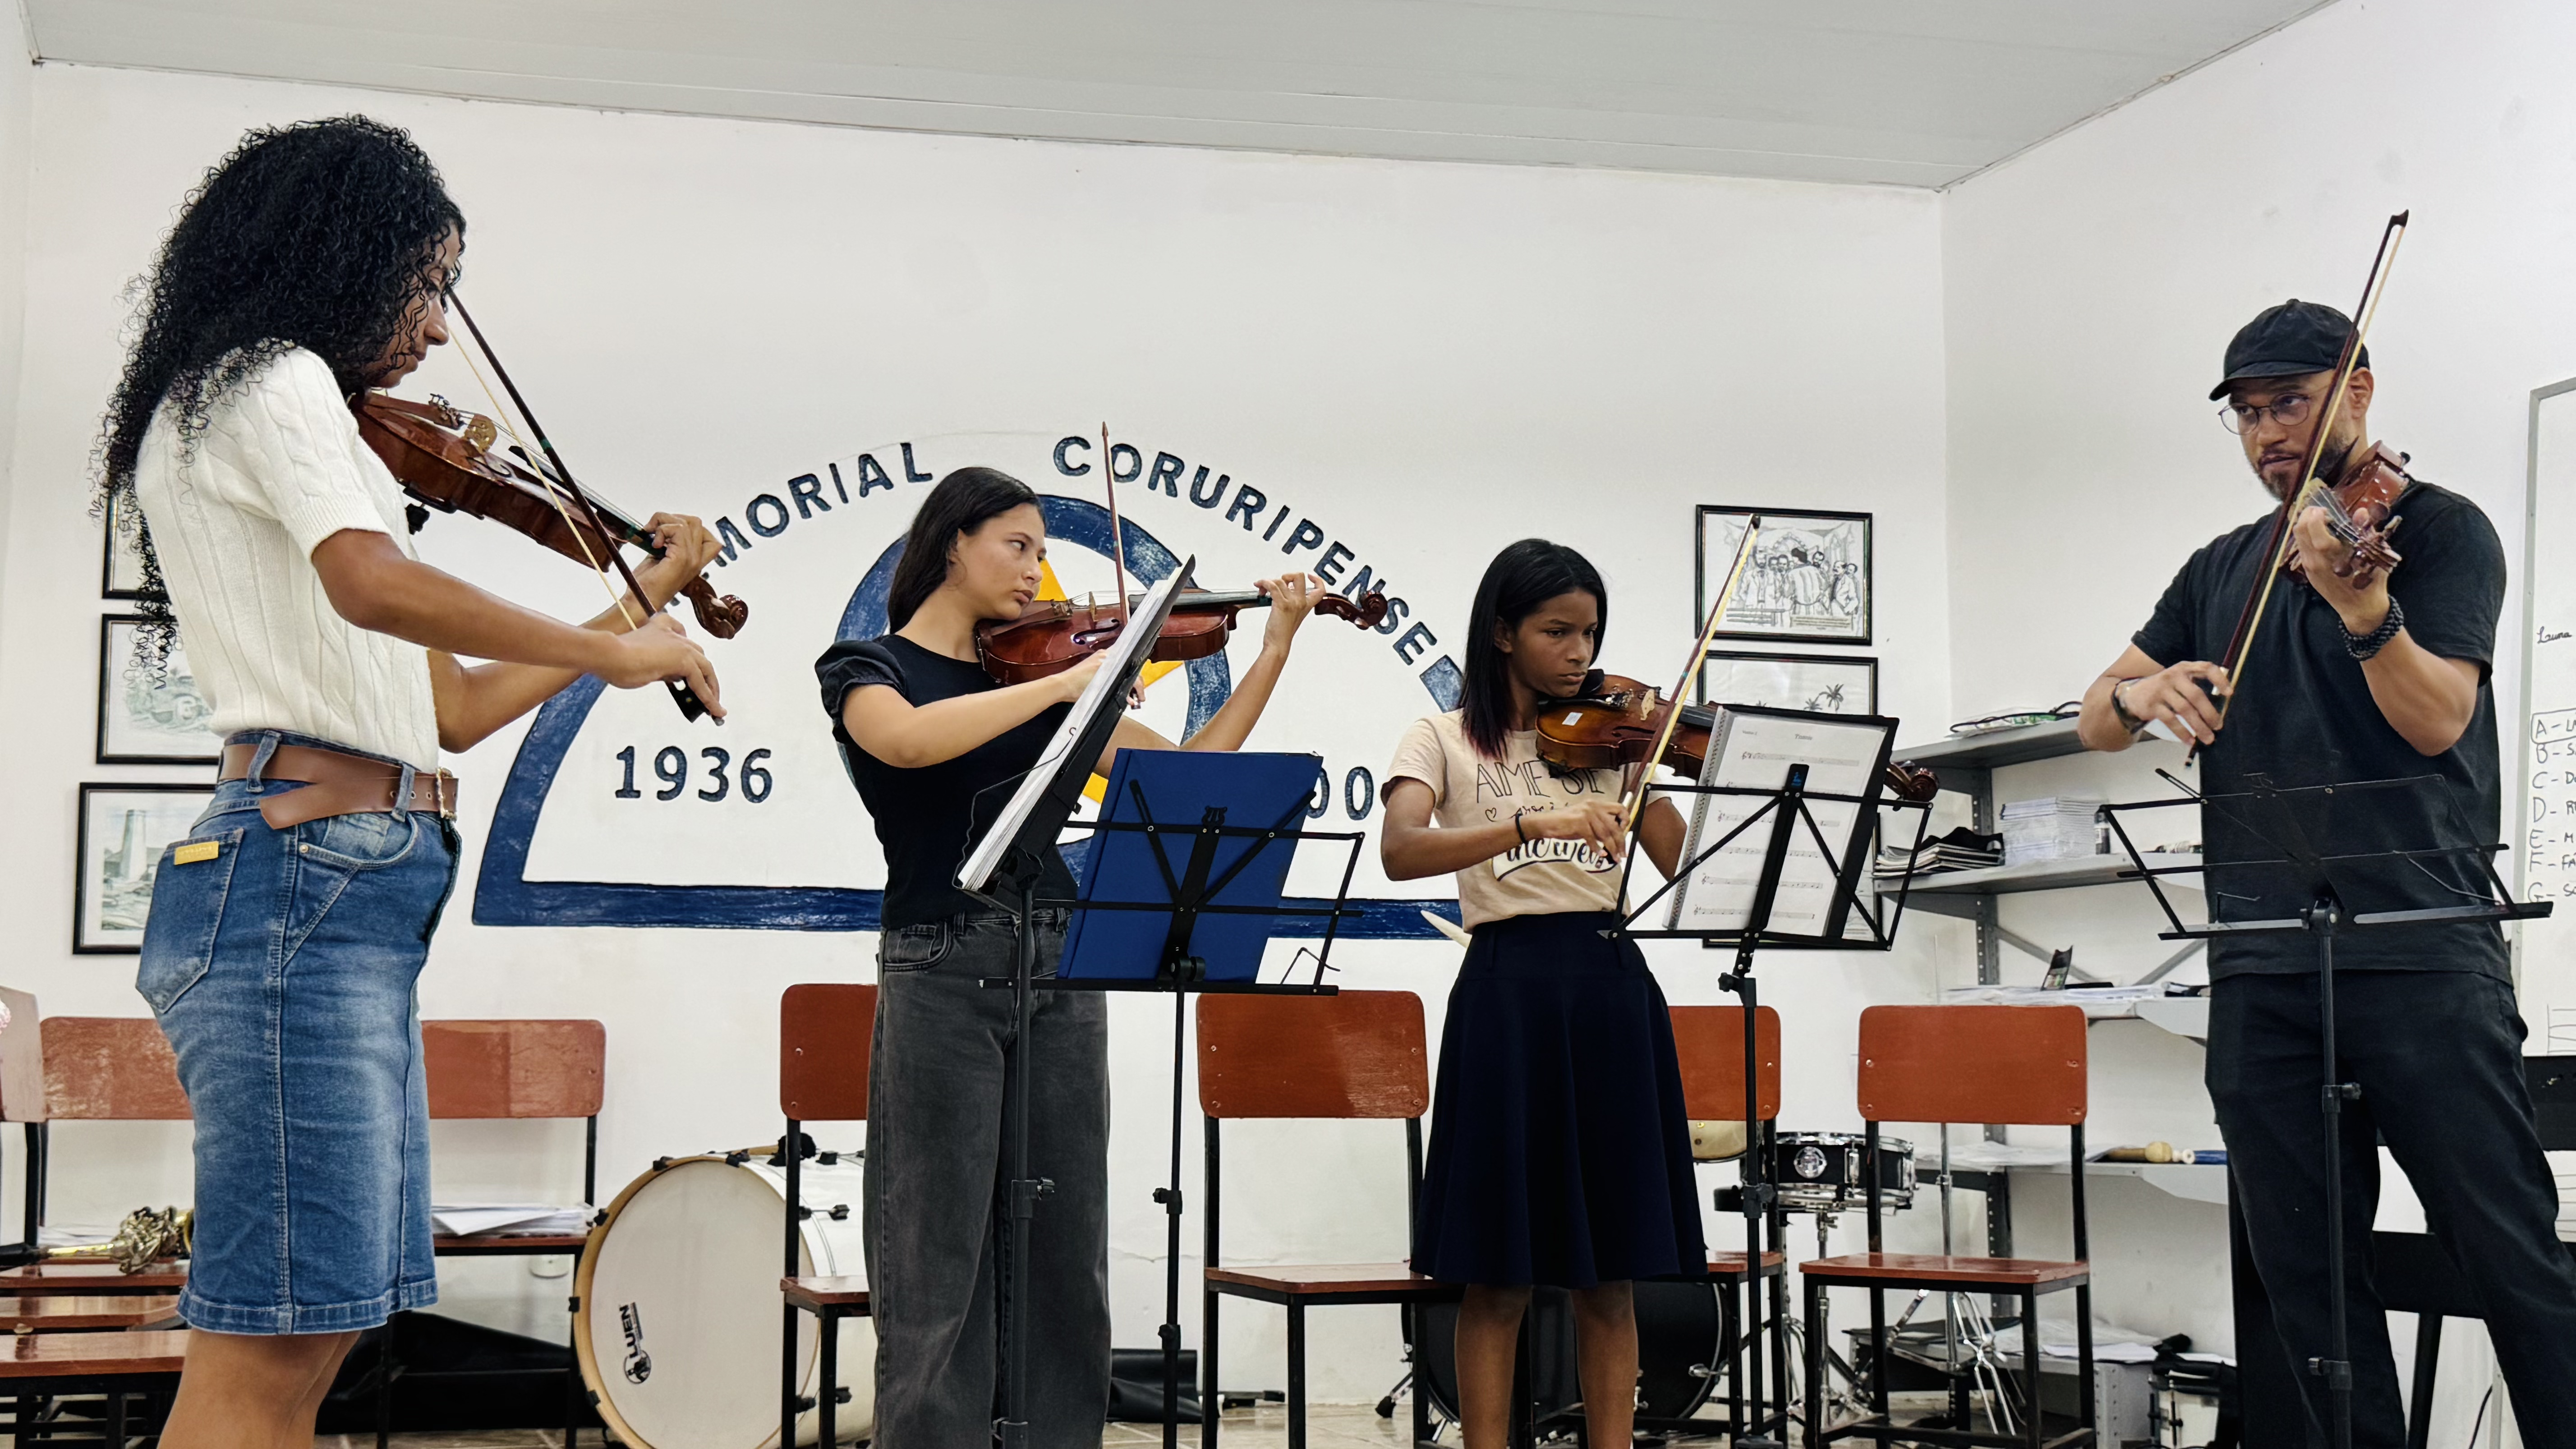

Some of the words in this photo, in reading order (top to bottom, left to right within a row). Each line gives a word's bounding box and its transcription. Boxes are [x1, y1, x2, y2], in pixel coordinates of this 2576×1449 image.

[670, 442, 933, 605] MORIAL
[1053, 436, 1437, 666] CORURIPENSE
[2535, 719, 2547, 739] A
[2536, 743, 2548, 764] B
[615, 745, 773, 804] 1936
[2532, 771, 2548, 789] C
[2533, 796, 2546, 823] D
[2529, 828, 2544, 849] E
[2529, 849, 2544, 873] F
